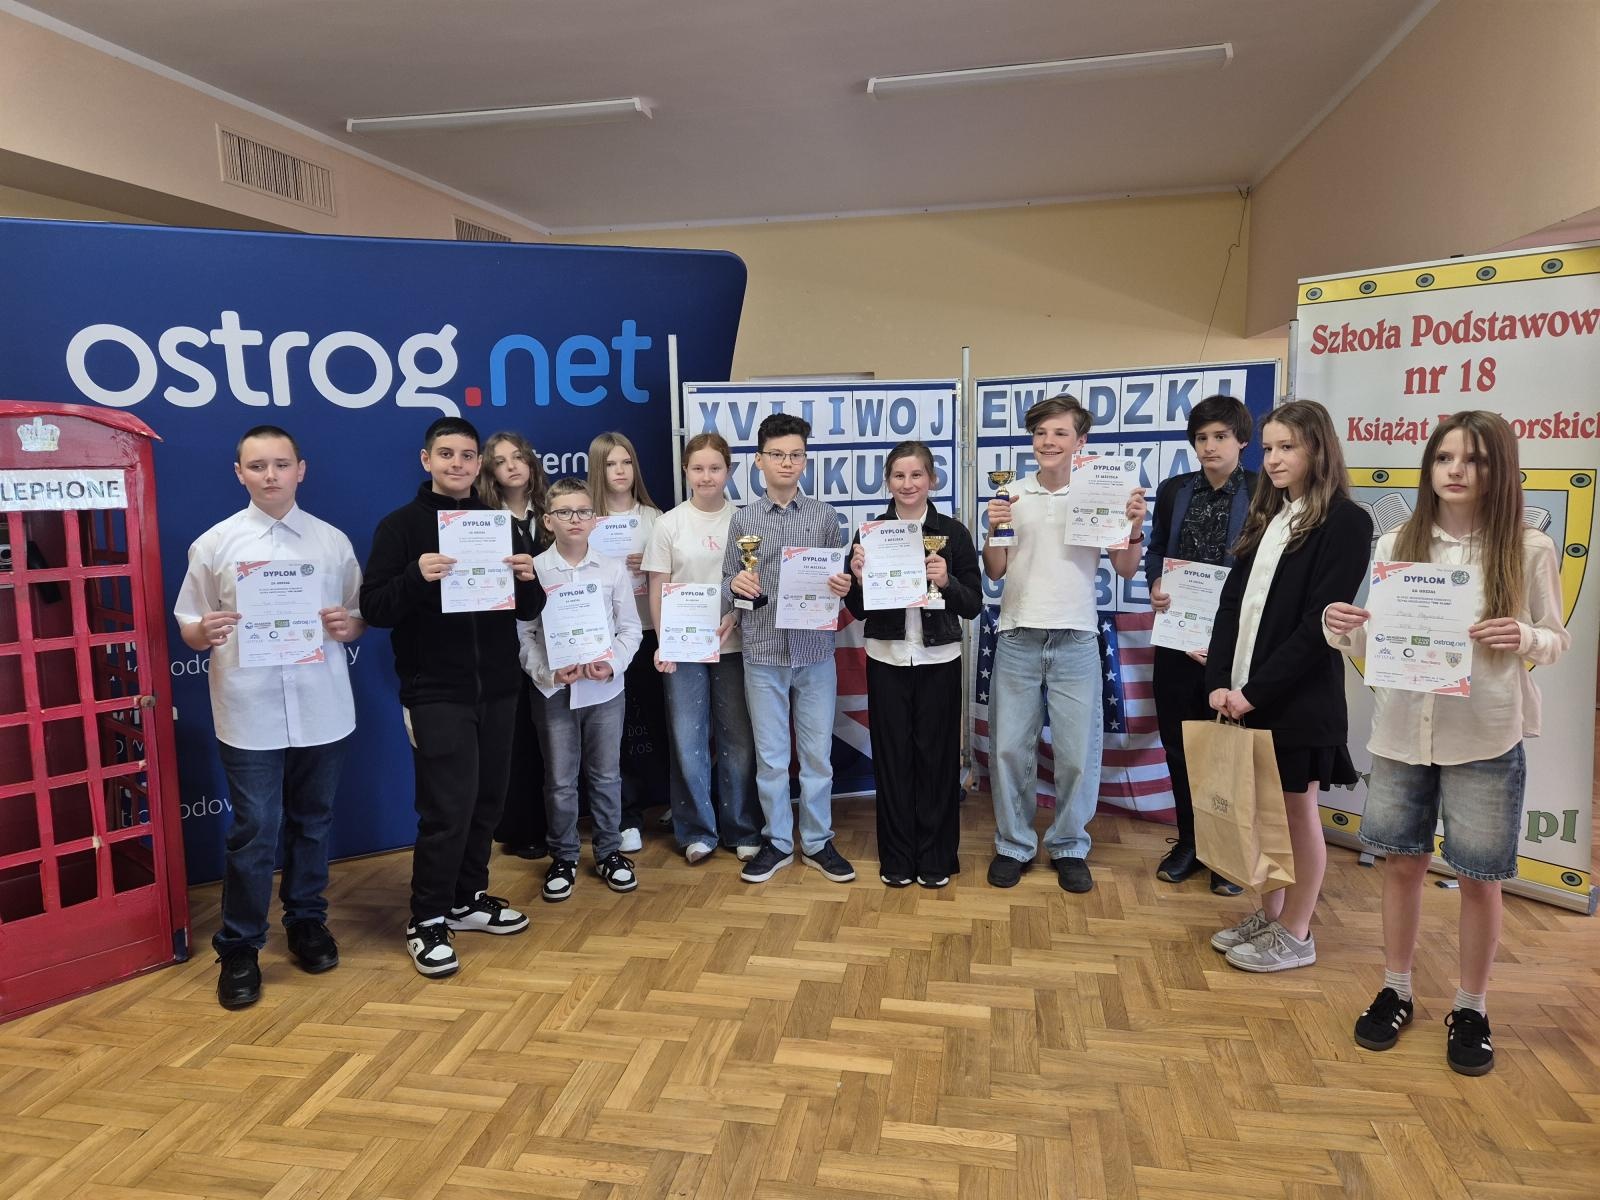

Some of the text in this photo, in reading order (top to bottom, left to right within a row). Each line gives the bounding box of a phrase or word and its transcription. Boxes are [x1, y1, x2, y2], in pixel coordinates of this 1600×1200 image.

[1310, 308, 1600, 355] Szkoła Podstawow
[66, 310, 652, 418] ostrog.net
[1404, 356, 1497, 395] nr 18
[1347, 416, 1429, 446] Książąt
[0, 480, 121, 501] LEPHONE
[1184, 569, 1211, 579] DYPLOM
[1403, 575, 1446, 585] DYPLOM
[559, 589, 584, 598] DYPLOM
[1433, 639, 1466, 648] ostrog.net
